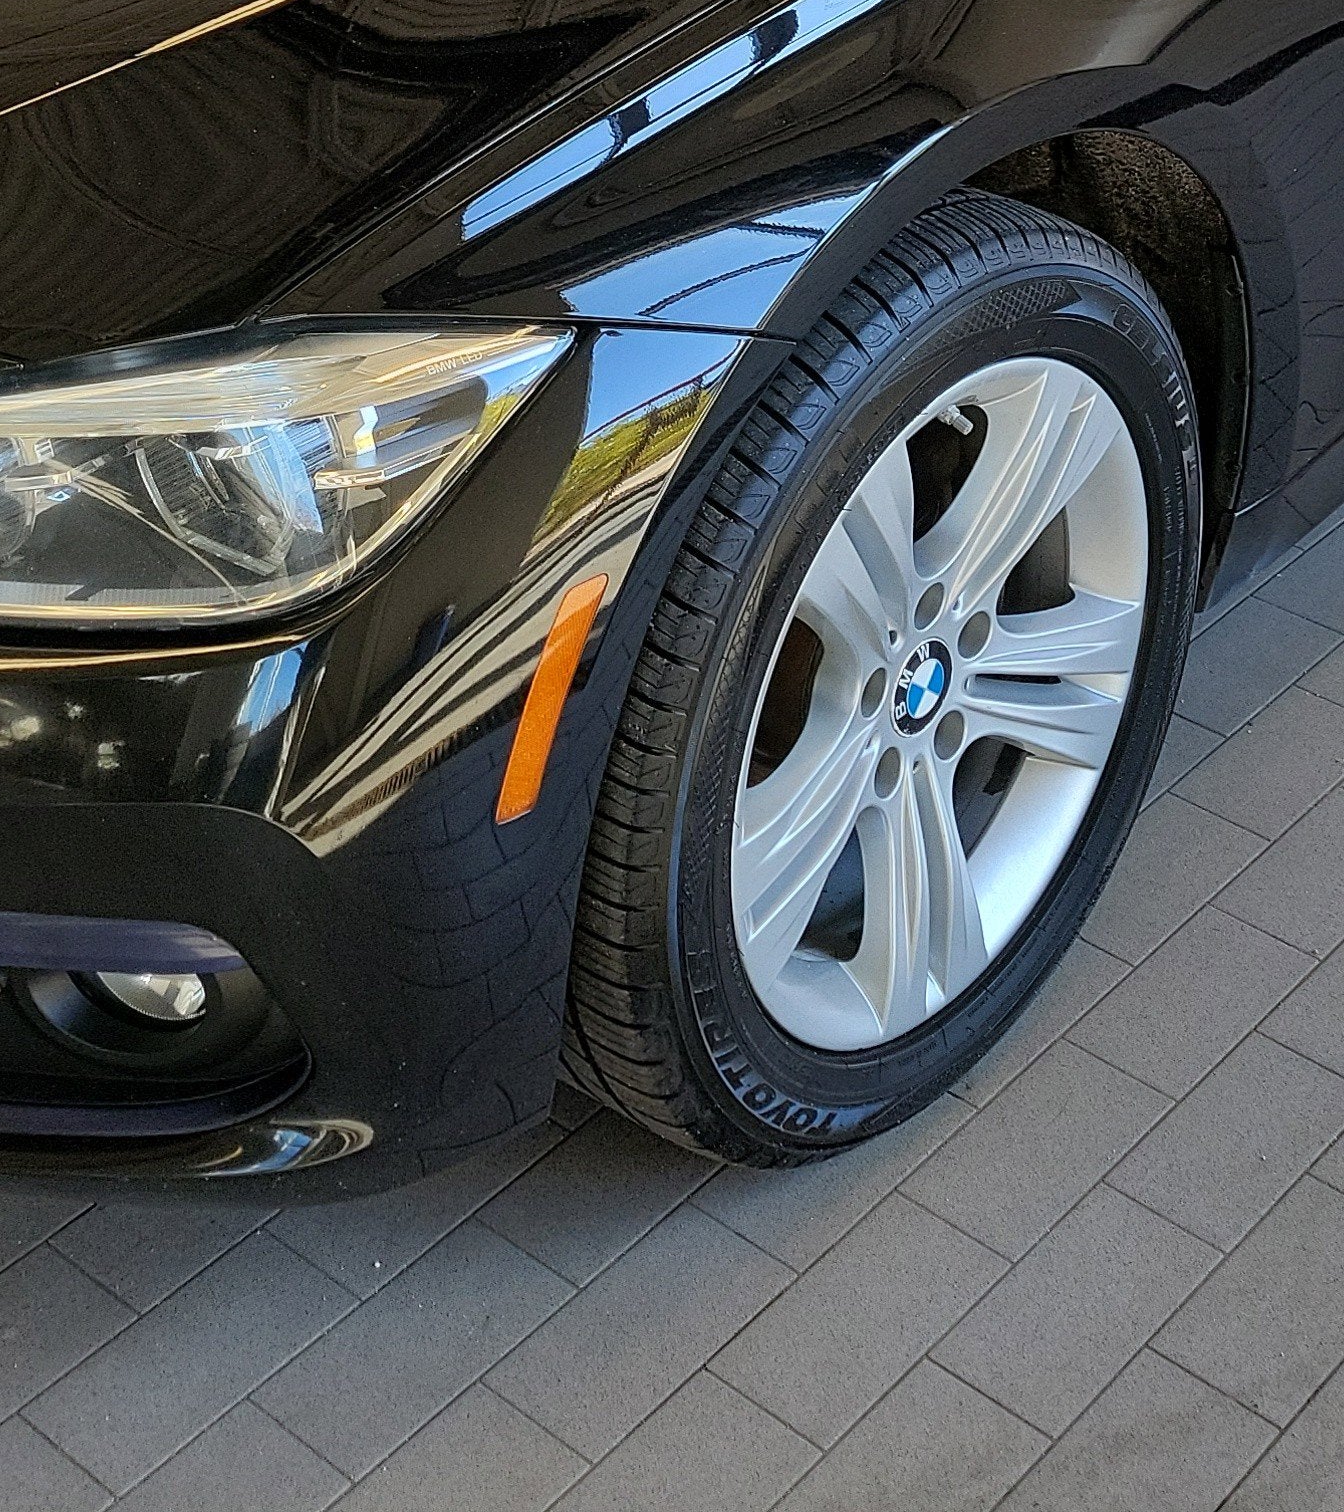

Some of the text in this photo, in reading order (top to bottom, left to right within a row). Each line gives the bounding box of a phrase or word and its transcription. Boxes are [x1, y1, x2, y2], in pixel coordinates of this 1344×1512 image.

[425, 351, 484, 375] BMW LED
[895, 642, 931, 721] BMW
[741, 1081, 839, 1137] TOYO
